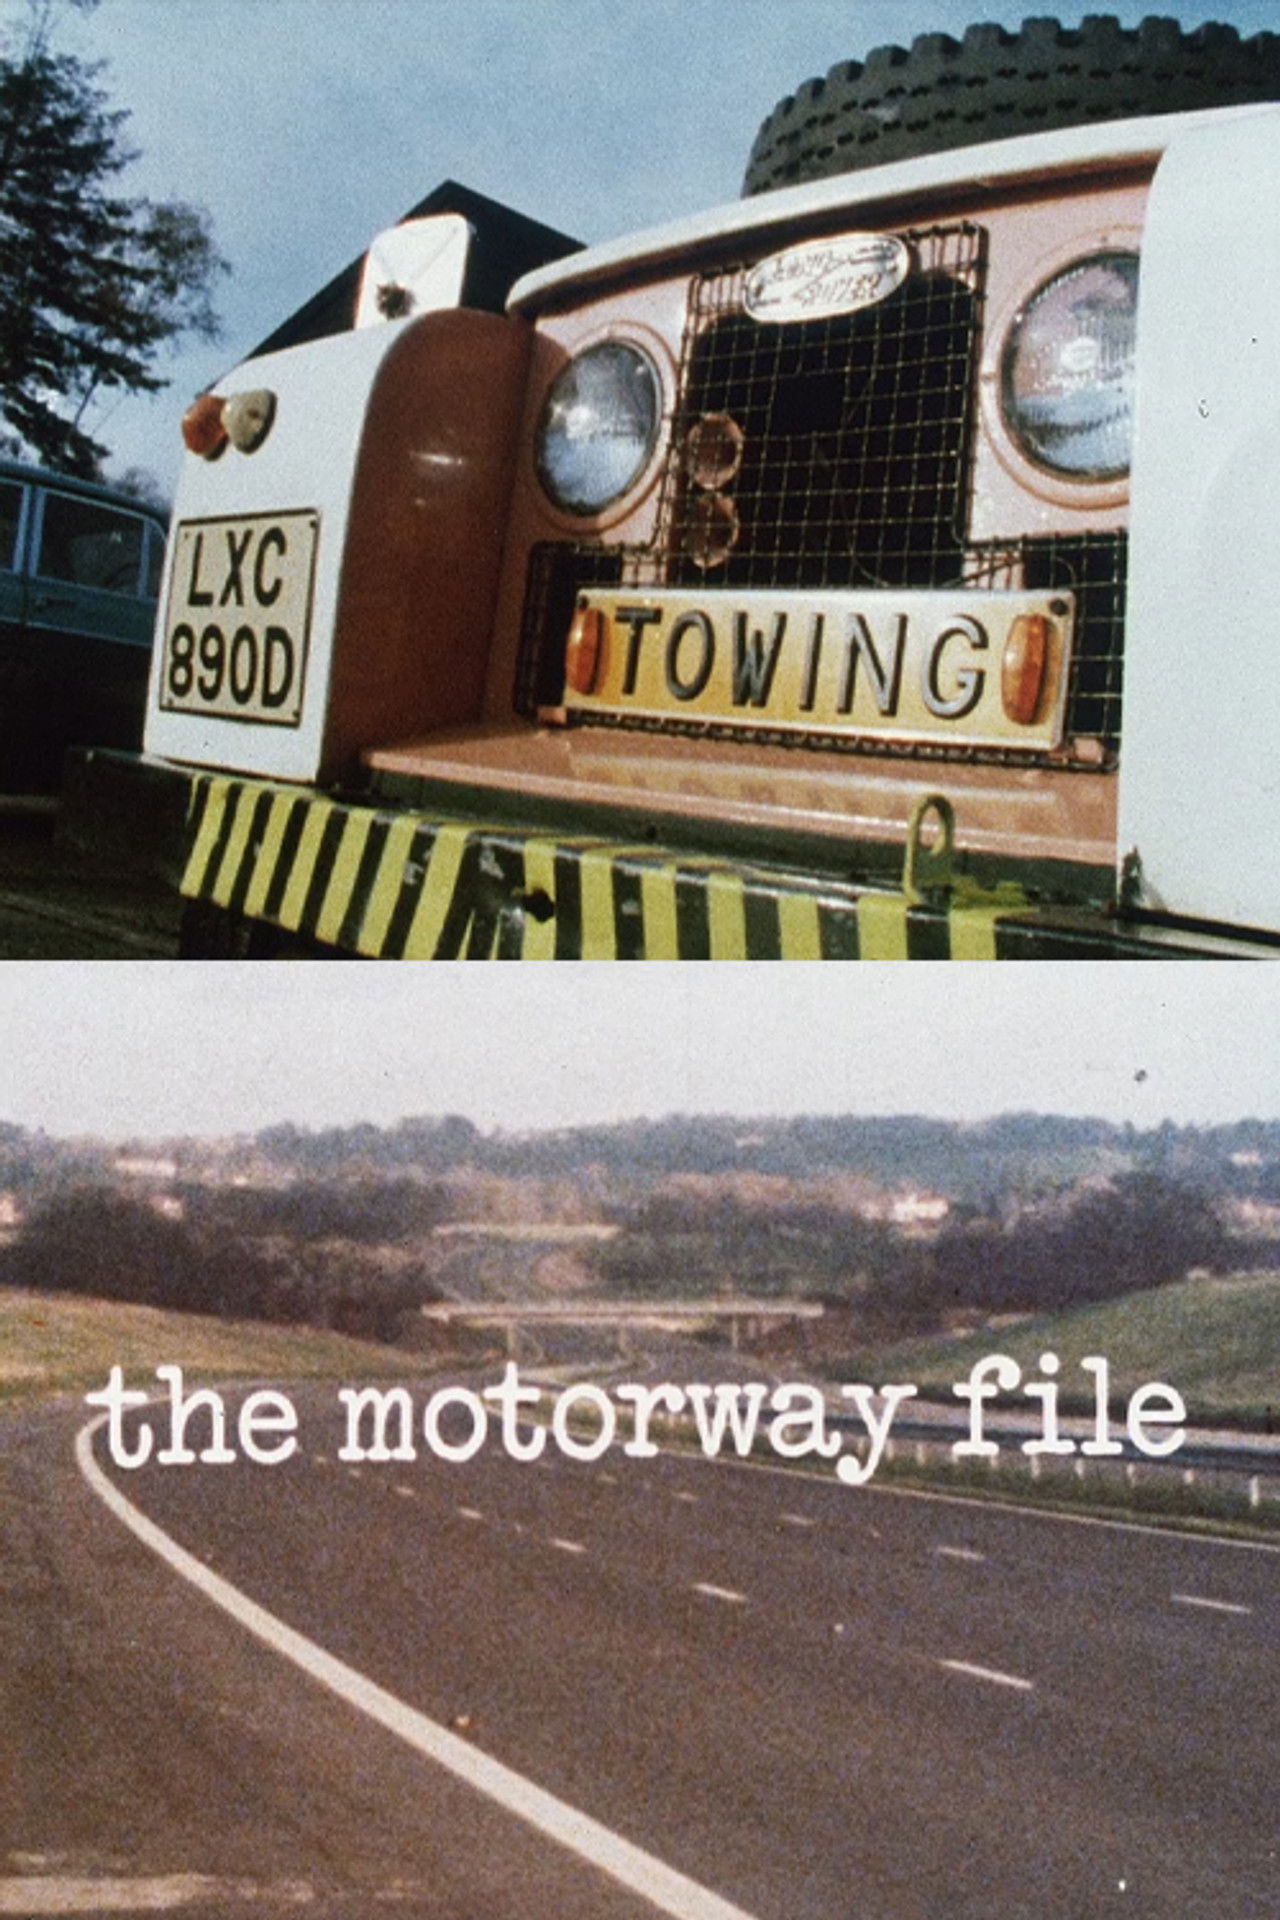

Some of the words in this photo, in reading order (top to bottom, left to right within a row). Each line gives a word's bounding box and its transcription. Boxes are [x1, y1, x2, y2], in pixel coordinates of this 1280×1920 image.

[187, 526, 287, 607] LXC
[168, 622, 295, 708] 890D
[614, 605, 990, 719] TOWING
